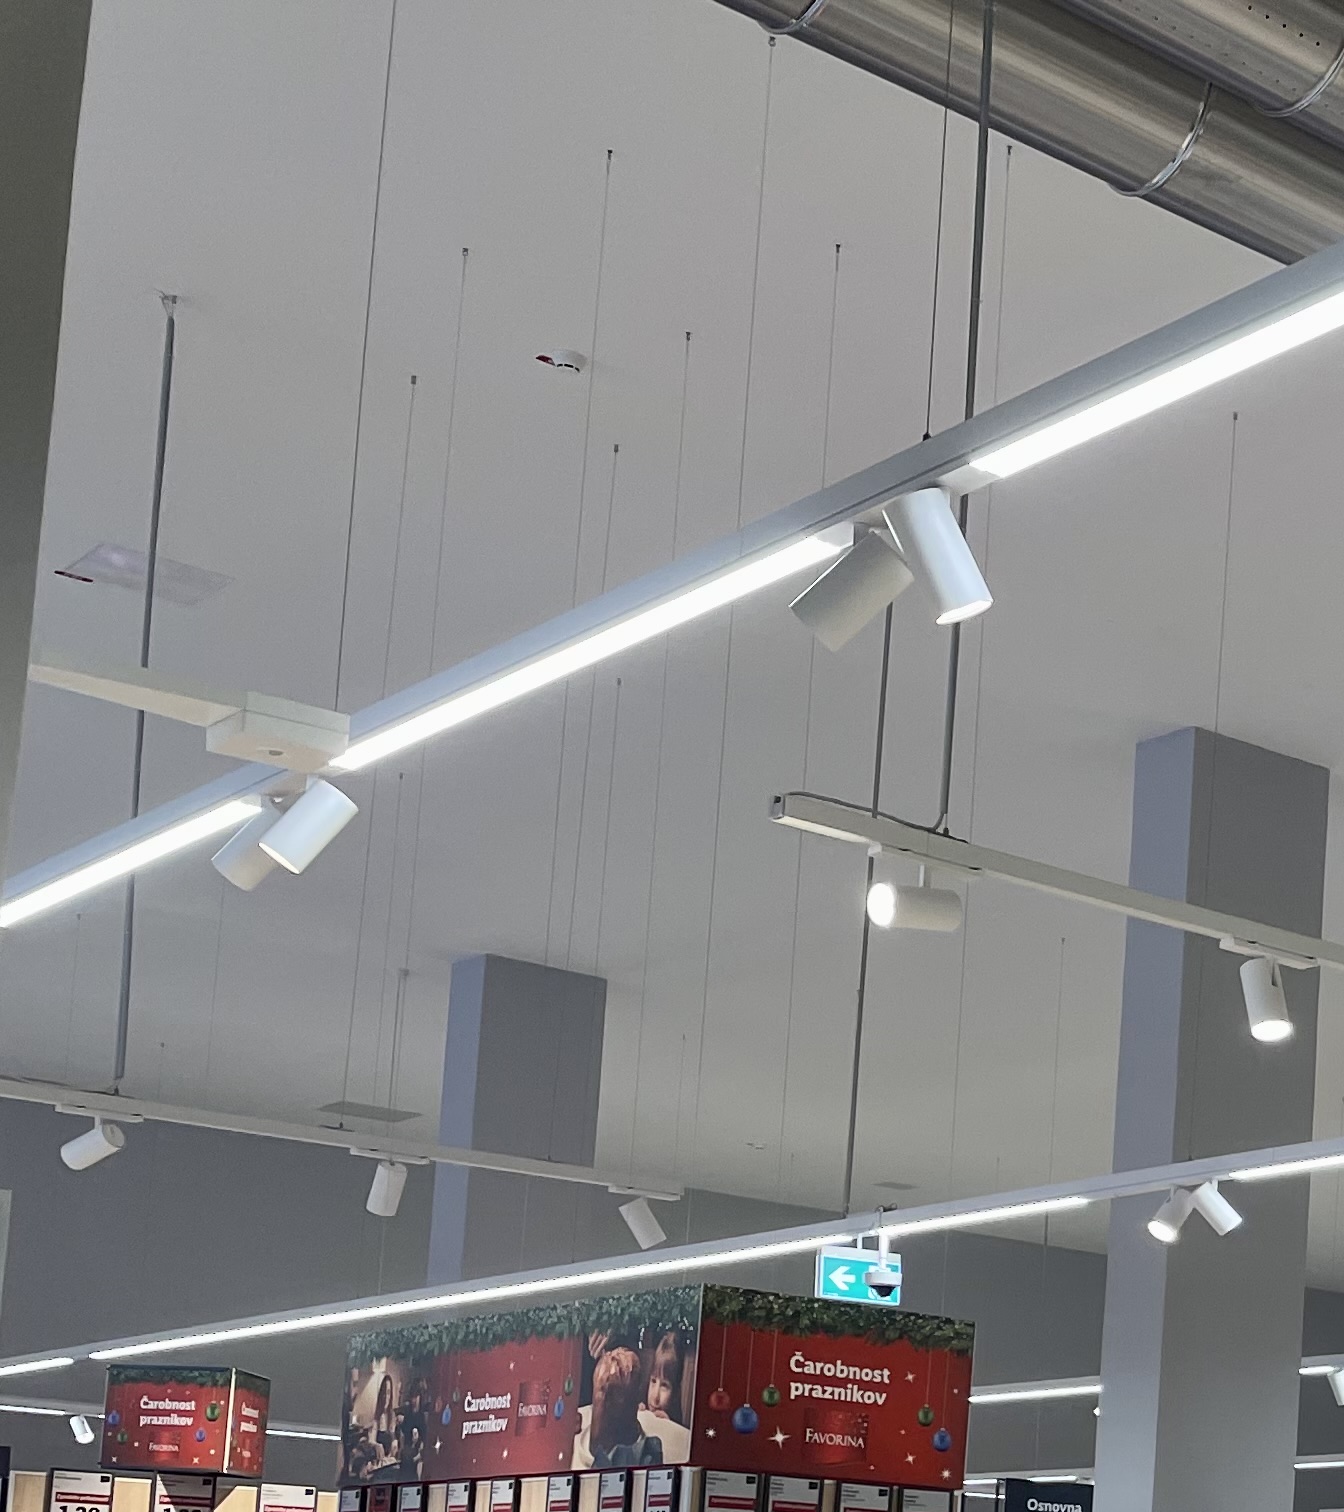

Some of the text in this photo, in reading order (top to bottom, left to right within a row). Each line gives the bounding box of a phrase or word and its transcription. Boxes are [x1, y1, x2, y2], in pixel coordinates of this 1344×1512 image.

[789, 1351, 890, 1383] Čarobnost
[140, 1395, 196, 1411] Čarobnost
[464, 1391, 512, 1413] Čarobnost
[789, 1381, 887, 1406] praznikov
[140, 1413, 194, 1427] praznikov
[461, 1415, 508, 1438] praznikov
[805, 1428, 865, 1449] FAVORINA
